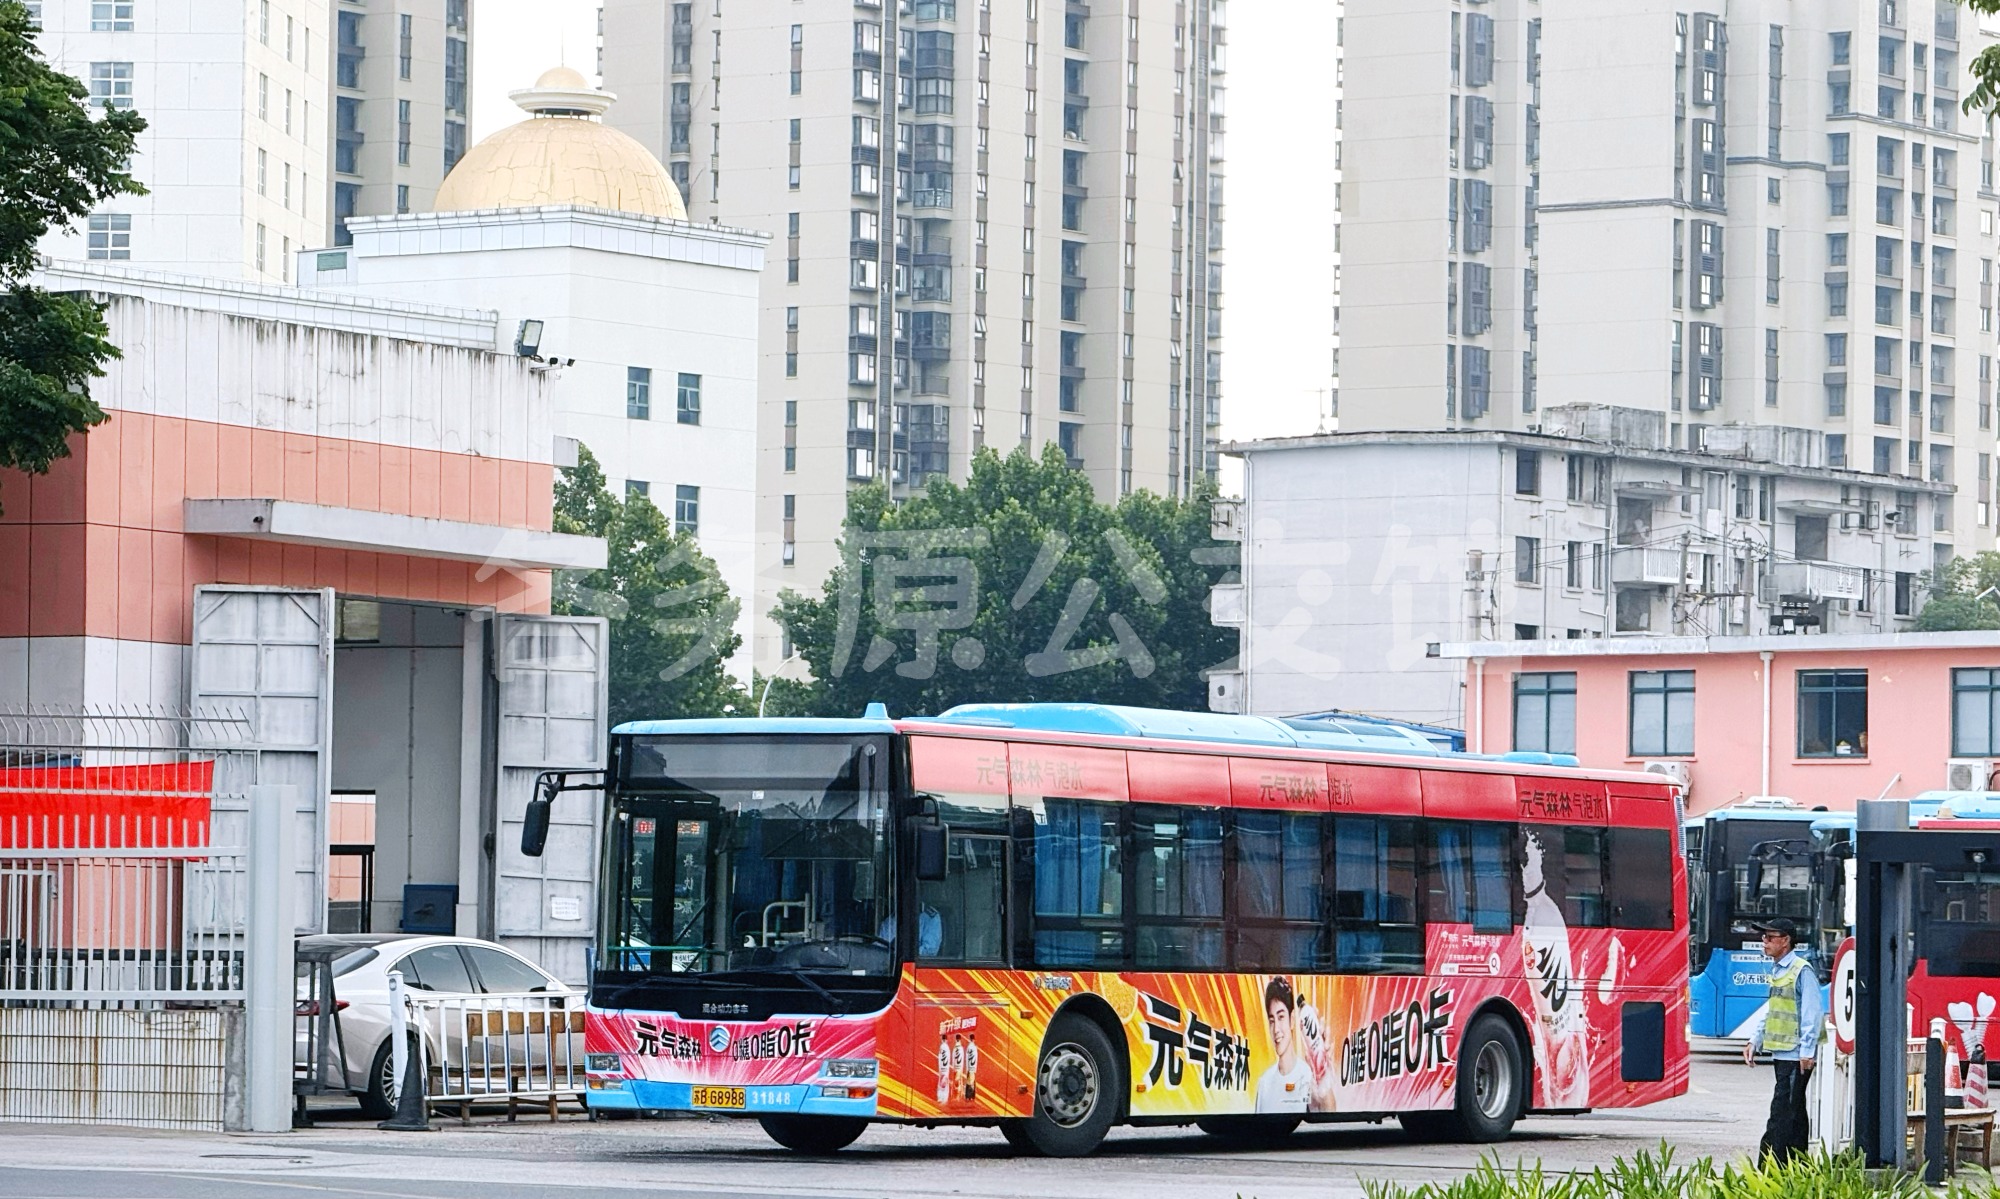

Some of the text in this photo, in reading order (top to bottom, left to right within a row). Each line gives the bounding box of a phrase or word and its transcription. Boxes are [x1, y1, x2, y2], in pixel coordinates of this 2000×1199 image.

[977, 757, 1083, 790] 元气森林气泡水
[1260, 775, 1354, 805] 元气森林气泡水
[1520, 791, 1604, 819] 元气森林气泡水
[1845, 970, 1854, 1022] 5
[635, 1019, 702, 1062] 元气森林
[1142, 991, 1251, 1092] 元气森林
[752, 1091, 791, 1105] 31848
